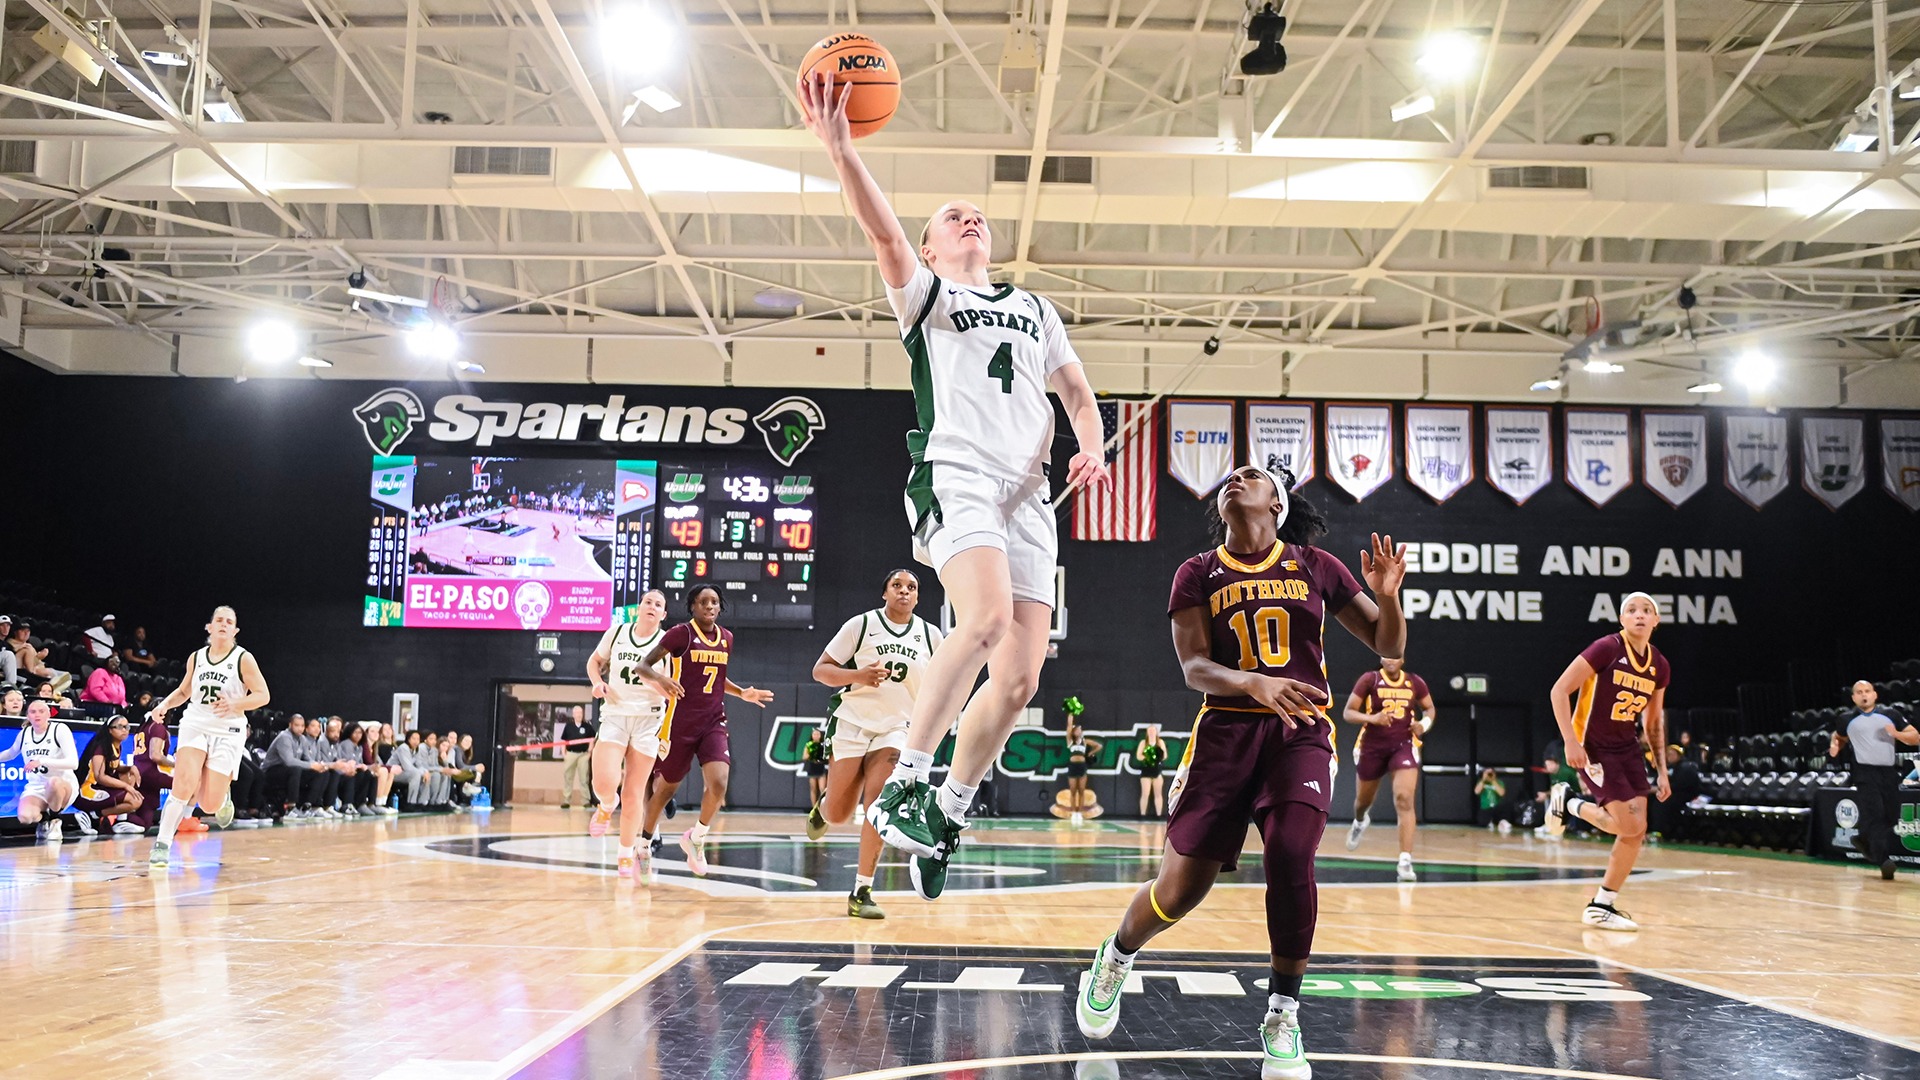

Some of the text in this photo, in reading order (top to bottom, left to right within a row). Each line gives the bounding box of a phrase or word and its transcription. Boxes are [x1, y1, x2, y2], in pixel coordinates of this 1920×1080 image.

[838, 55, 887, 72] NCAA
[949, 309, 1040, 343] UPSTATE
[987, 341, 1014, 394] 4
[428, 395, 748, 446] Spartans
[1255, 417, 1305, 425] CHARLESTON
[1416, 425, 1435, 433] HIGH
[1416, 435, 1461, 443] UNIVERSITY
[1586, 459, 1611, 486] PC
[664, 481, 706, 494] Upstate
[773, 483, 814, 496] Upstate
[726, 511, 751, 520] PERIOD
[386, 527, 393, 539] 2
[398, 528, 405, 539] 0
[671, 520, 702, 547] 43
[731, 520, 745, 541] 3
[780, 523, 811, 549] 40
[617, 533, 651, 544] 10 4 0
[398, 540, 404, 551] 2
[629, 544, 639, 556] 12
[644, 545, 651, 556] 2
[397, 552, 404, 563] 0
[672, 550, 691, 559] FOULS
[714, 551, 763, 561] PLAYER FOULS
[795, 553, 814, 562] FOULS
[615, 556, 625, 567] 22
[643, 557, 650, 568] 2
[1396, 543, 1743, 579] EDDIE AND ANN
[370, 563, 377, 574] 4
[396, 563, 403, 575] 2
[643, 568, 650, 580] 2
[673, 559, 688, 580] 2
[695, 559, 707, 577] 3
[767, 562, 779, 577] 4
[802, 563, 811, 582] 1
[367, 574, 402, 586] 42 4 1
[616, 580, 623, 591] 7
[642, 580, 649, 592] 2
[665, 580, 685, 589] POINTS
[726, 582, 746, 591] MATCH
[787, 583, 808, 592] POINTS
[410, 584, 510, 611] EL PASO
[1208, 578, 1310, 618] WINTHROP
[570, 605, 595, 615] EVERY
[1402, 589, 1738, 625] PAYNE AENA
[422, 611, 450, 620] TACOS
[459, 611, 496, 621] TEQUILA
[560, 615, 603, 625] WEDNESDAY
[542, 639, 555, 649] EXIT
[1228, 606, 1291, 671] 10
[875, 643, 918, 661] UPSTATE
[199, 671, 228, 684] UPSTATE
[884, 660, 909, 683] 13
[702, 665, 719, 694] 7
[199, 685, 221, 705] 25
[1382, 699, 1409, 719] 25
[1610, 690, 1648, 722] 22
[26, 748, 50, 757] UPSTATE
[1841, 806, 1853, 817] FOX
